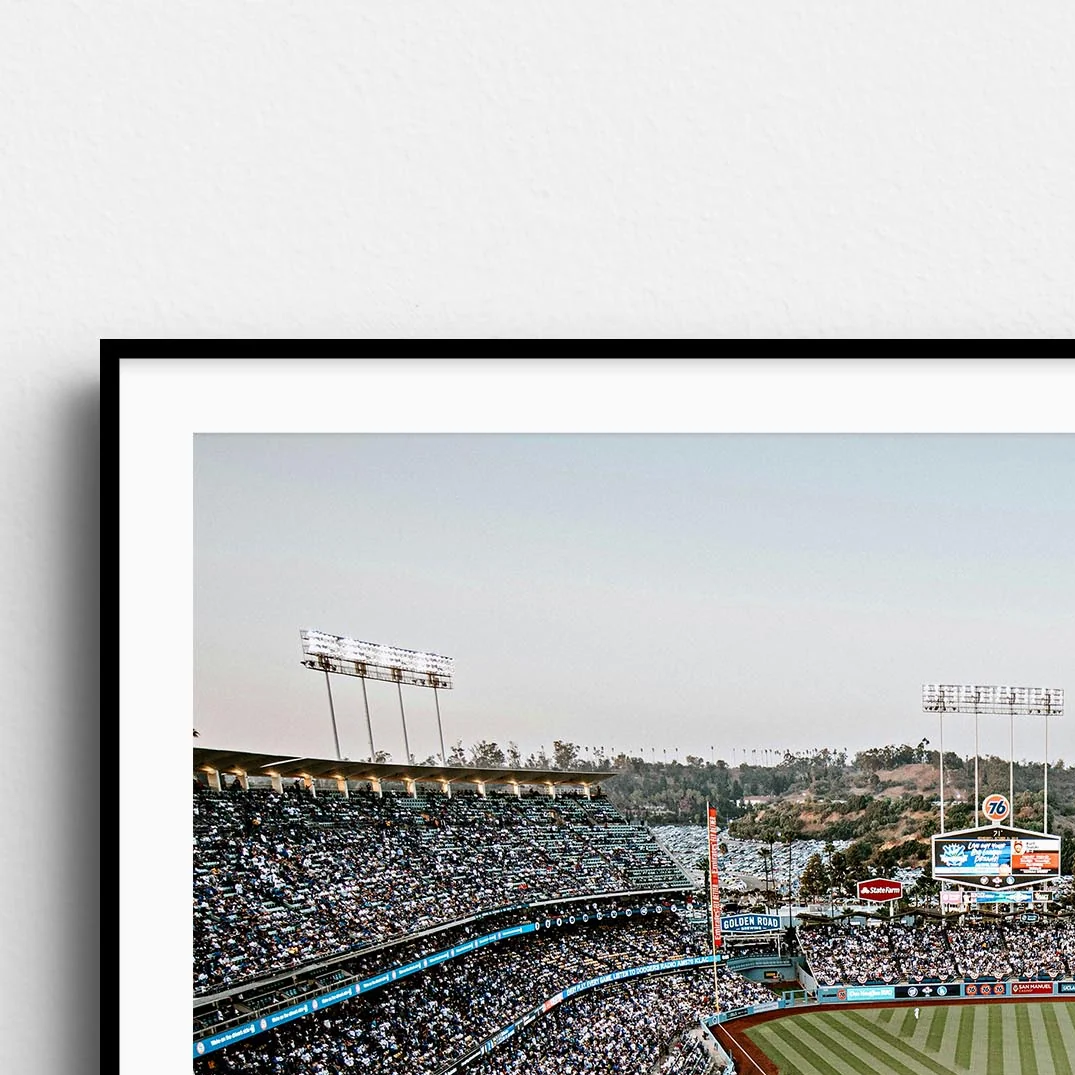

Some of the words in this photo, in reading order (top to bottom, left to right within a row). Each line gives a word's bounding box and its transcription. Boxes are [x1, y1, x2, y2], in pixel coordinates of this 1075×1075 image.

[988, 800, 1006, 815] 76
[724, 918, 755, 930] GOLDEN
[757, 916, 778, 927] ROAD
[636, 964, 660, 974] DODGERS
[660, 961, 676, 970] RADIO
